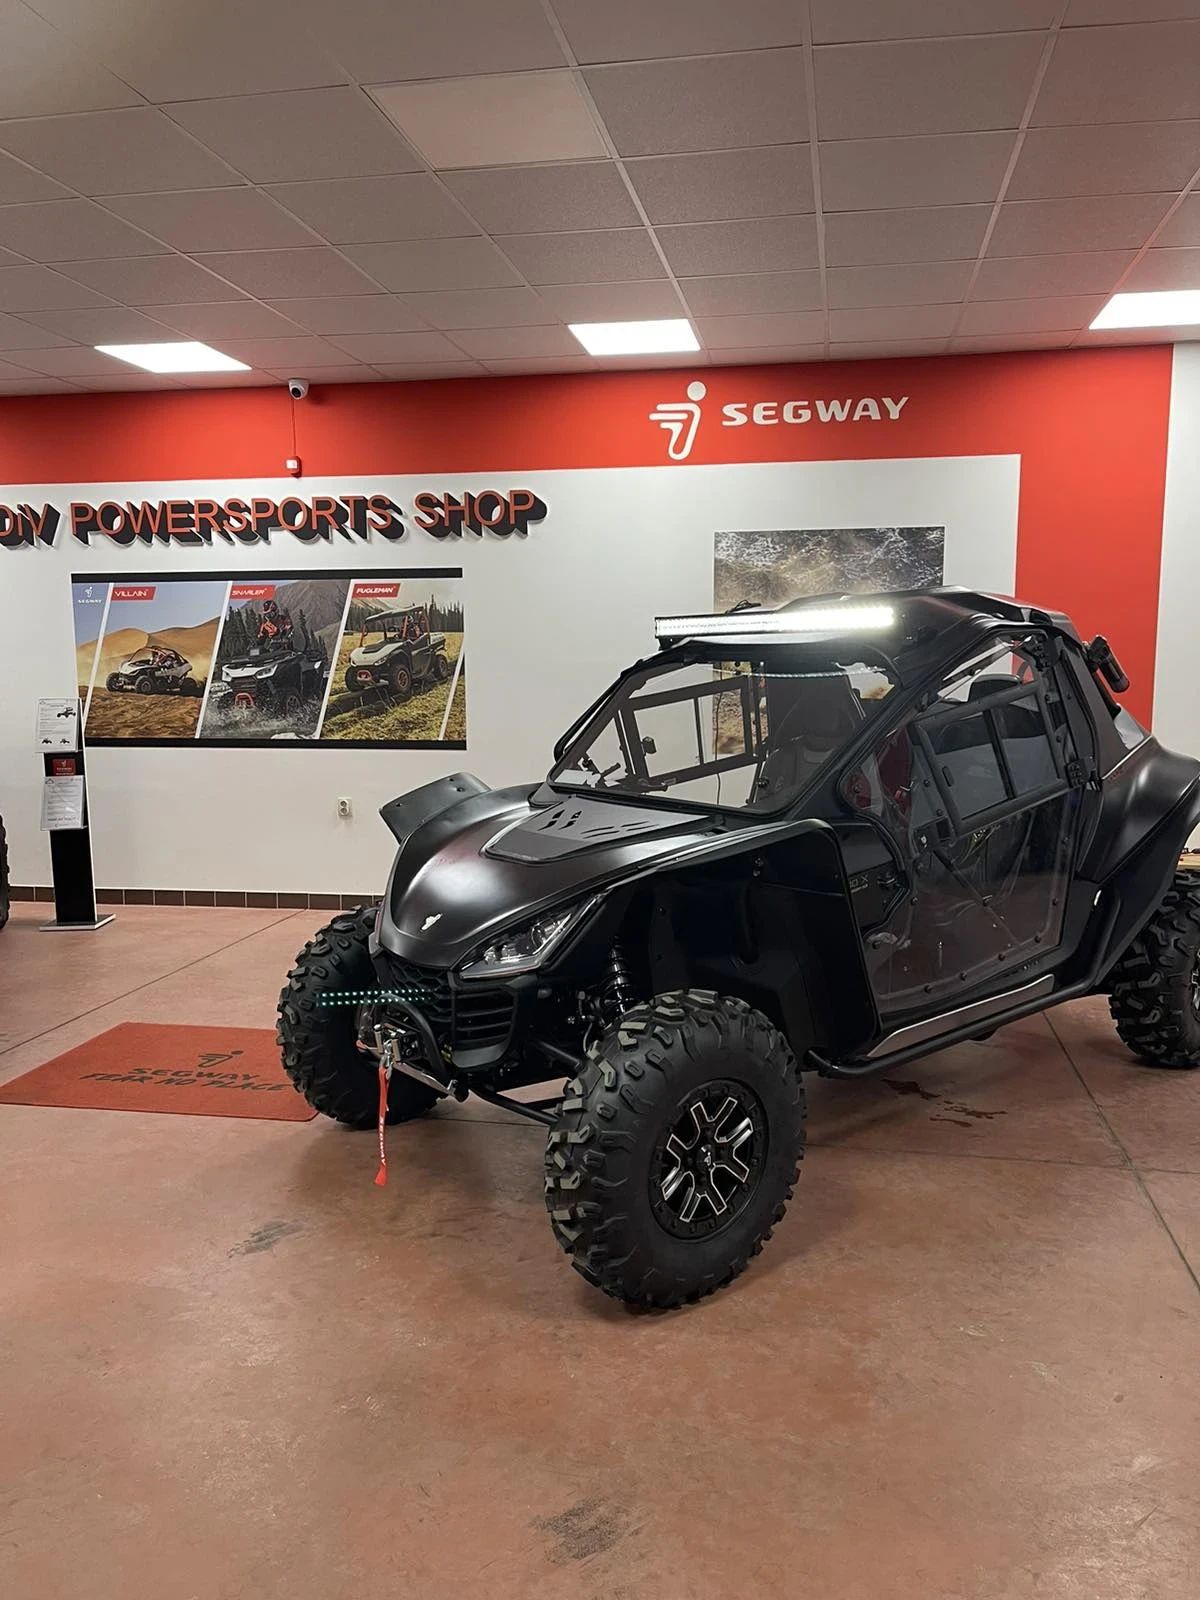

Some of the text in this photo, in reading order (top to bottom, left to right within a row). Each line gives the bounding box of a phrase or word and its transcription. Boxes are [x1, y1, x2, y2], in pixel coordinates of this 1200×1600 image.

[722, 397, 908, 426] SEGWAY
[70, 495, 403, 544] POWERSPORTS
[414, 489, 546, 538] SHOP
[114, 589, 147, 597] VILLAIN
[356, 587, 394, 595] FUGLEMAN
[80, 1072, 292, 1091] FEAR NO PLACE
[128, 1067, 260, 1081] SEGWAY
